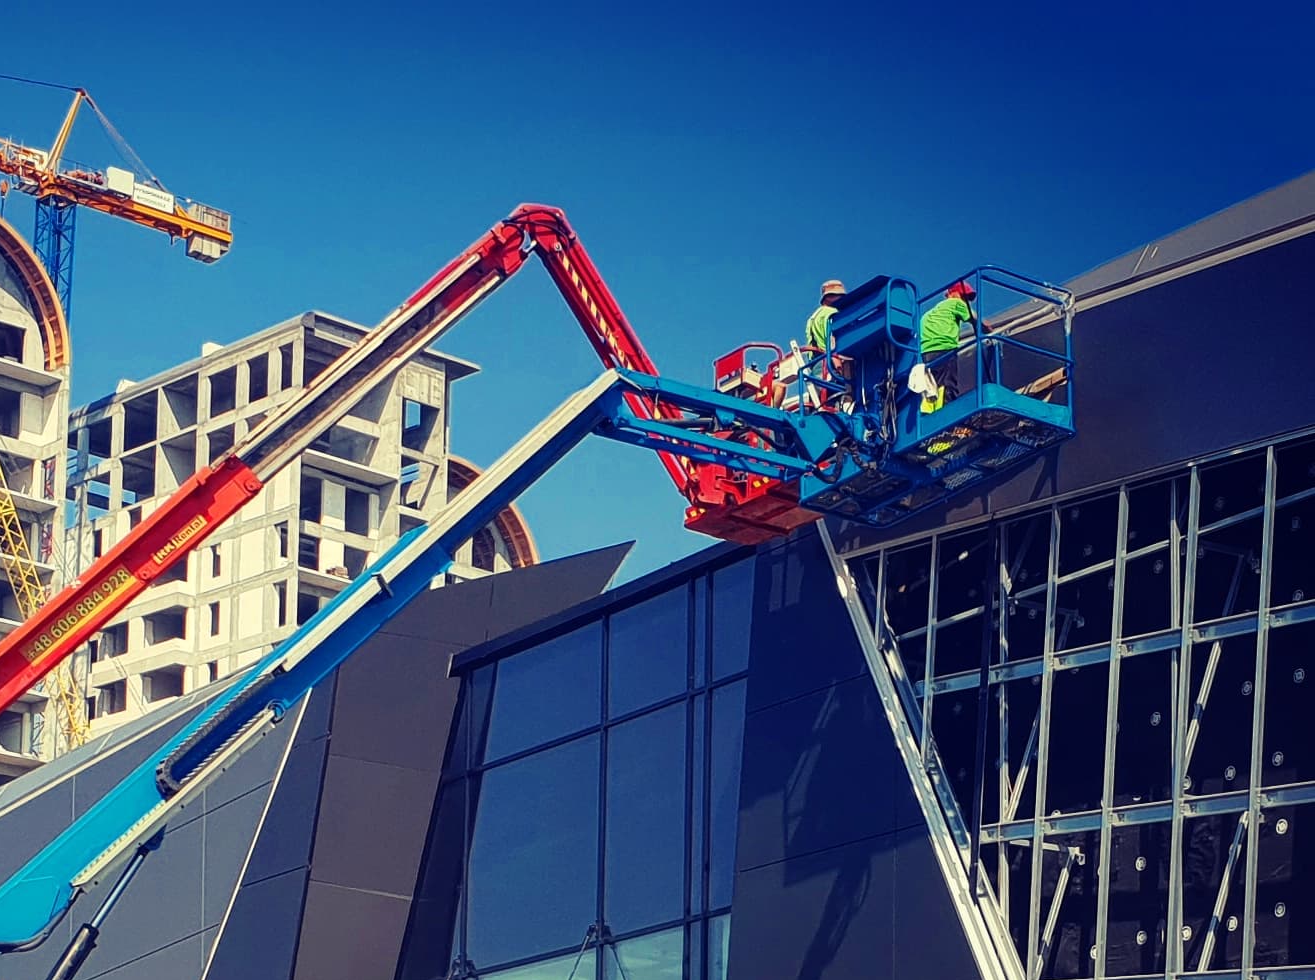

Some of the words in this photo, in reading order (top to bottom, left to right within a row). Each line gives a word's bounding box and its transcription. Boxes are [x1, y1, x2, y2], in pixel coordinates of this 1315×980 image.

[172, 515, 203, 544] Rental
[26, 633, 53, 659] +48
[50, 611, 78, 639] 606
[75, 590, 104, 617] 884
[102, 568, 130, 594] 928
